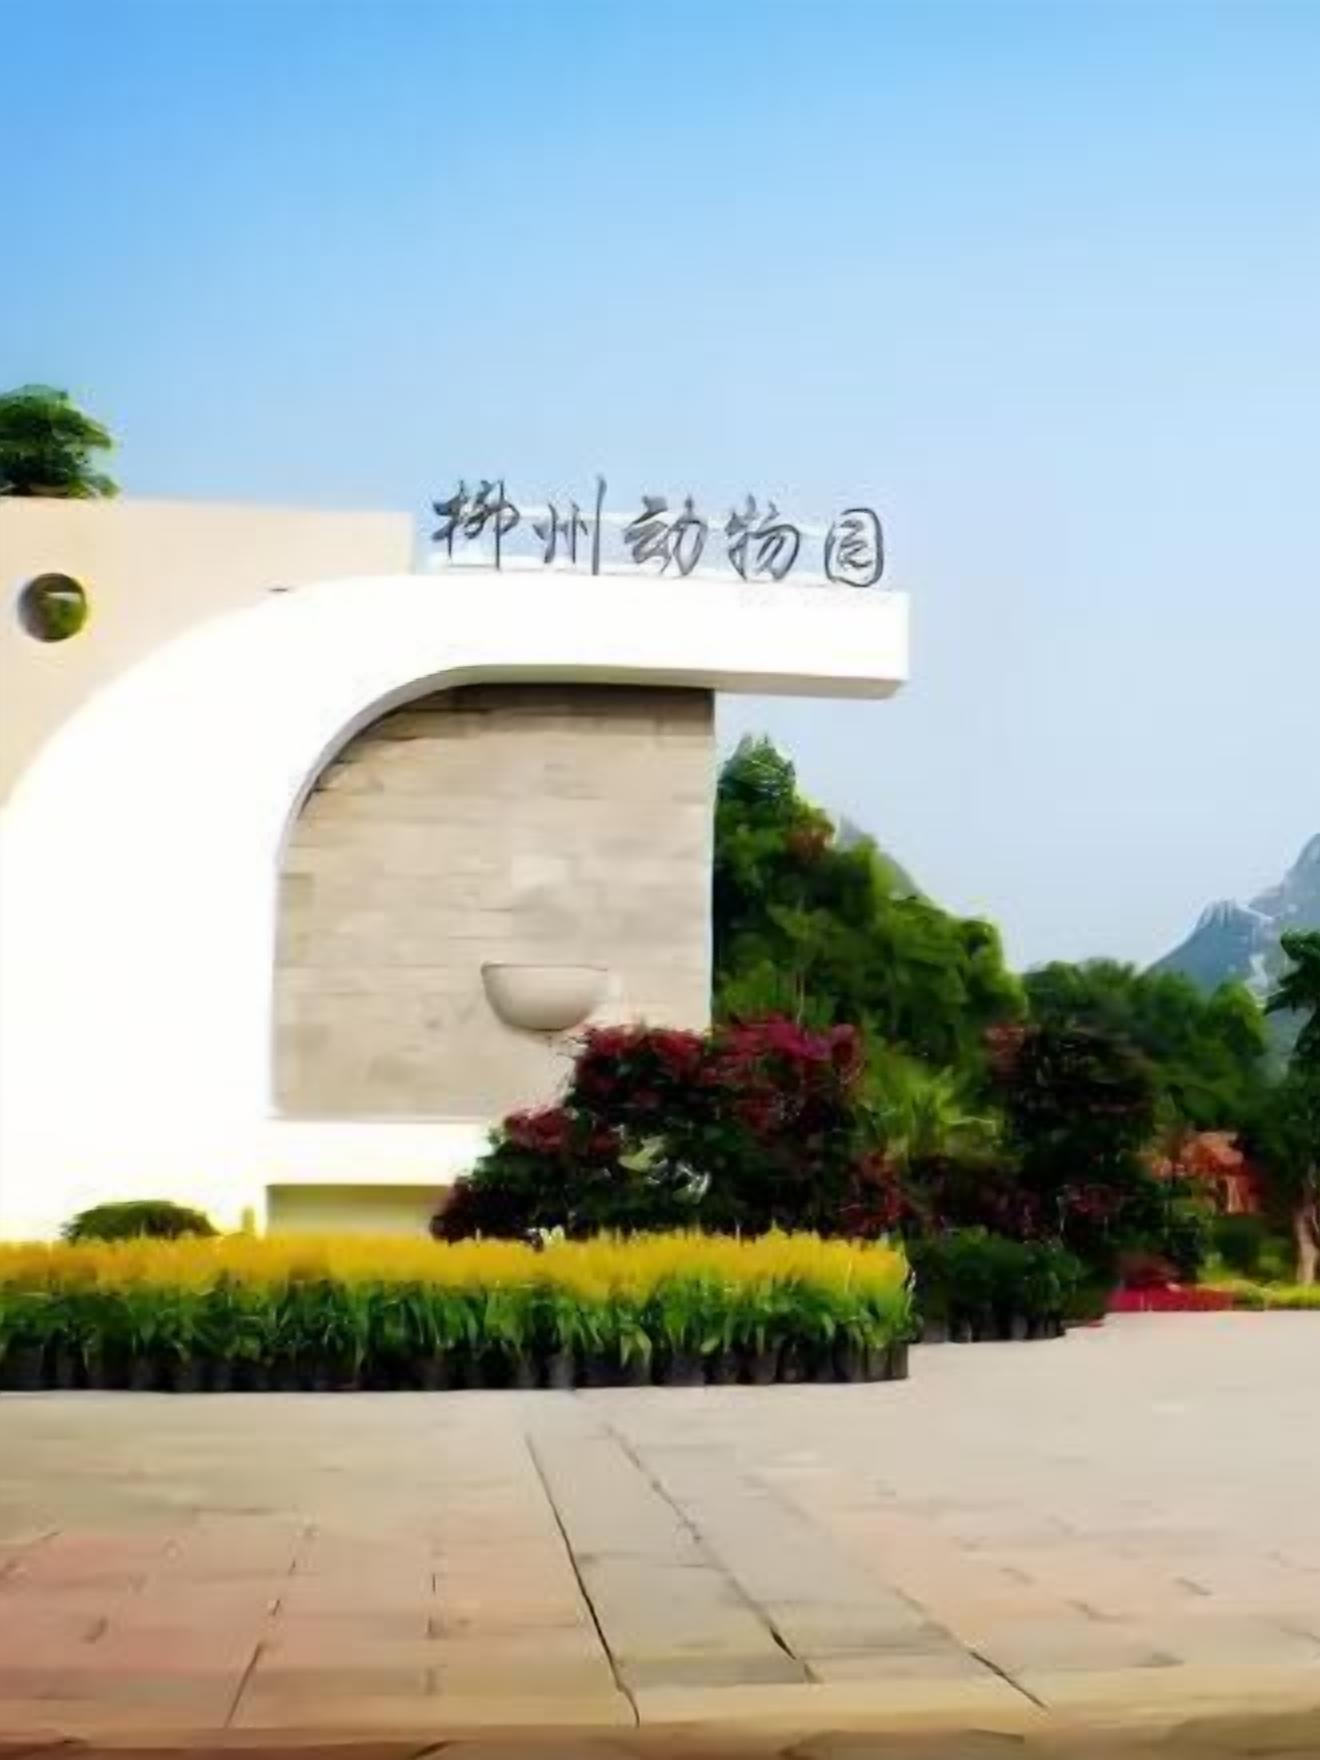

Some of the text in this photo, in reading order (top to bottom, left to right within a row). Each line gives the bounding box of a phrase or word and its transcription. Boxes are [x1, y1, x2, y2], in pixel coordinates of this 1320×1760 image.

[432, 474, 884, 587] 柳州动物园
